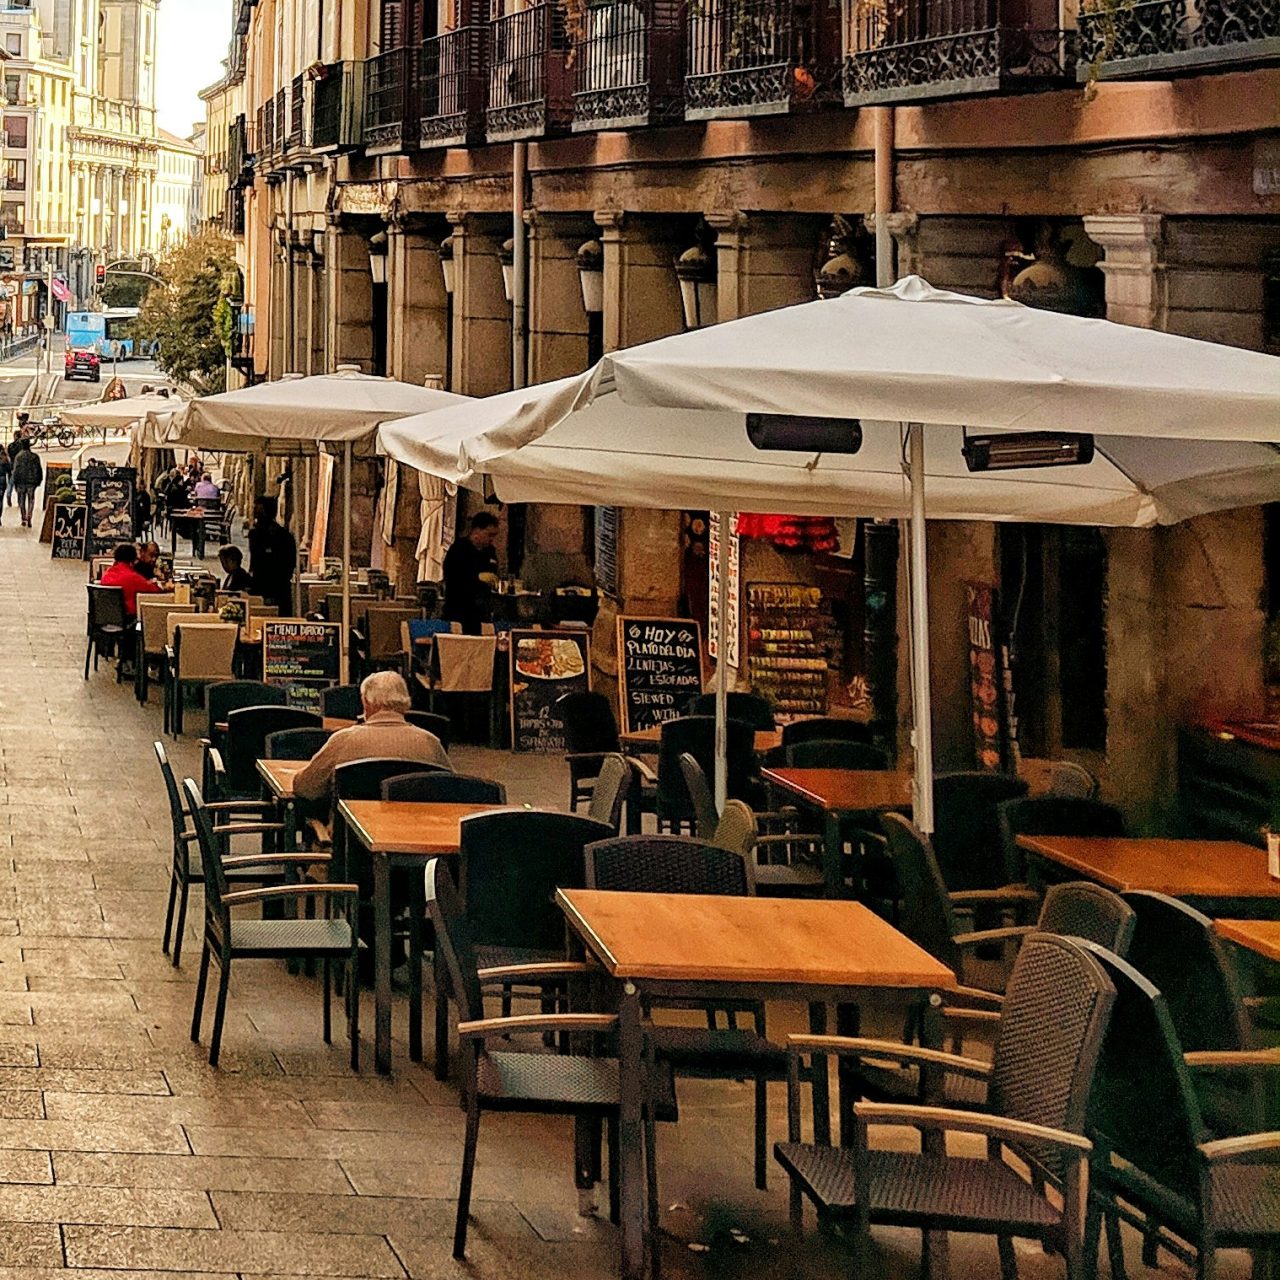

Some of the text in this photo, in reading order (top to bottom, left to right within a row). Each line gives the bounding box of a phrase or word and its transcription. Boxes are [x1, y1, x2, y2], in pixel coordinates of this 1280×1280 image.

[644, 626, 677, 644] HOY
[626, 640, 658, 656] PLATO
[659, 644, 676, 656] DEL
[627, 657, 676, 674] LENTEJAS
[649, 675, 700, 686] ESTOFADAS
[631, 692, 675, 705] STEWED
[652, 708, 681, 721] WITH
